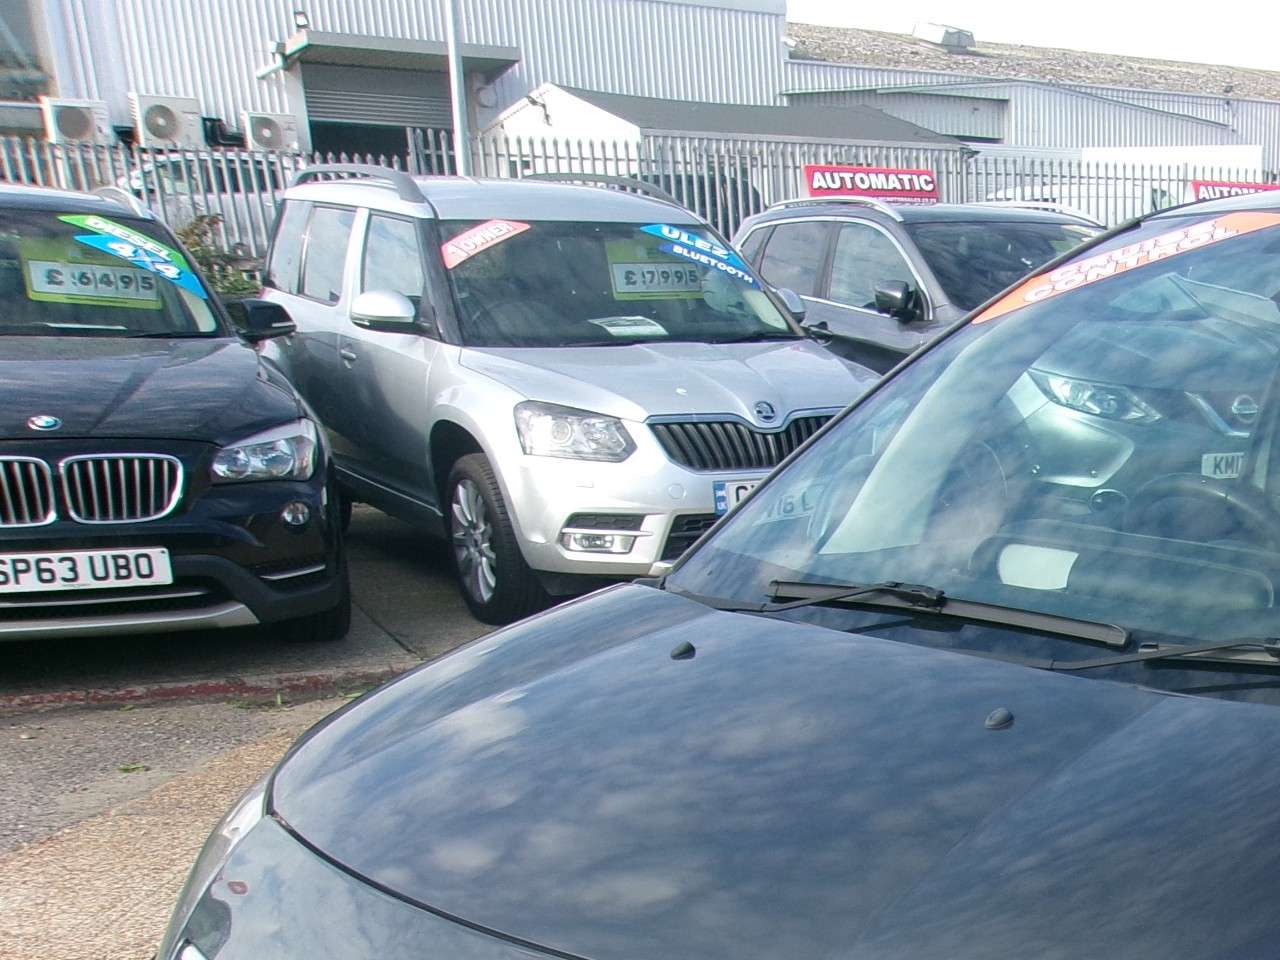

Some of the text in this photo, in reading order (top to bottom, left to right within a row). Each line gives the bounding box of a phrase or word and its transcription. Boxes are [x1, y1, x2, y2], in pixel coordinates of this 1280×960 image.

[812, 172, 935, 192] AUTOMATIC
[661, 225, 729, 259] ULEZ
[672, 245, 753, 284] BLUETOOTH
[0, 556, 79, 586] SP63
